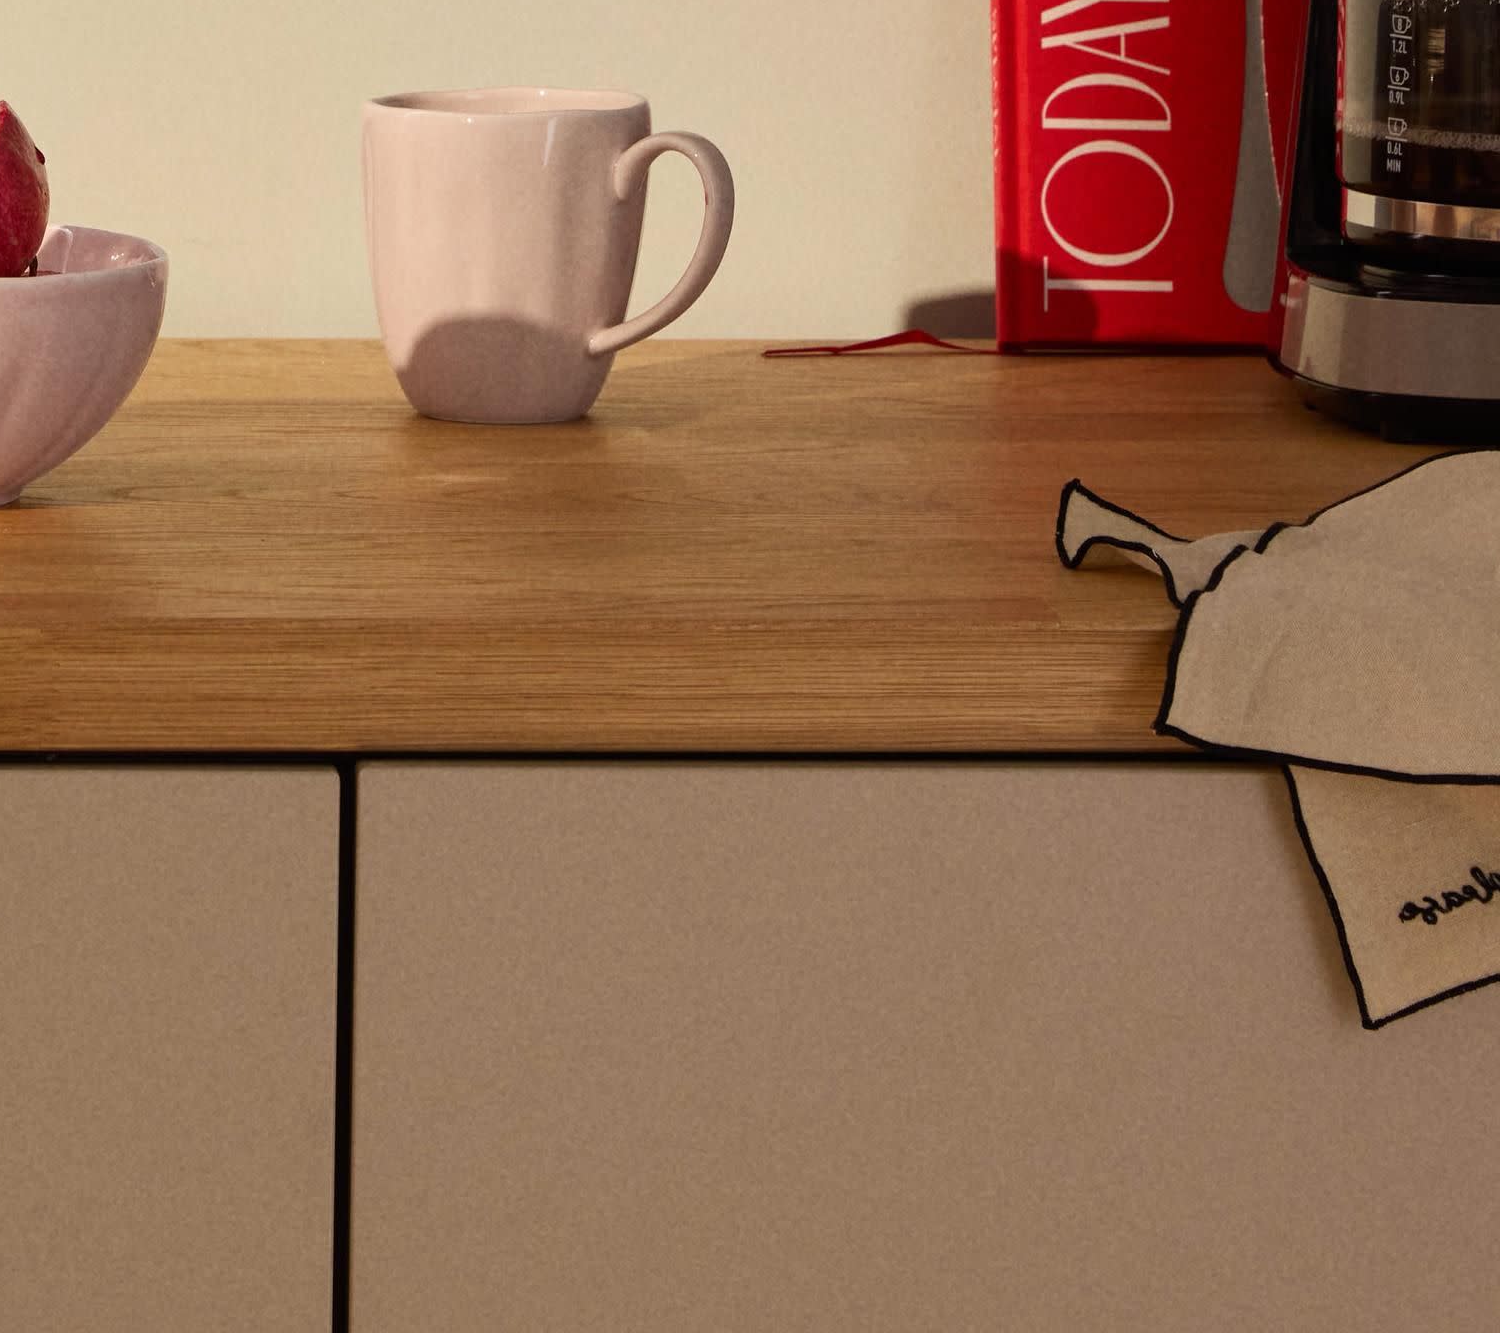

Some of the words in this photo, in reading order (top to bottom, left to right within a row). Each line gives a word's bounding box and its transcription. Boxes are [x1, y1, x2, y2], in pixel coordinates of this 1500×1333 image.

[1392, 40, 1407, 54] 1.2L
[1389, 90, 1404, 105] 0.9L
[1387, 141, 1402, 156] 0.6L
[1386, 160, 1401, 172] MIN
